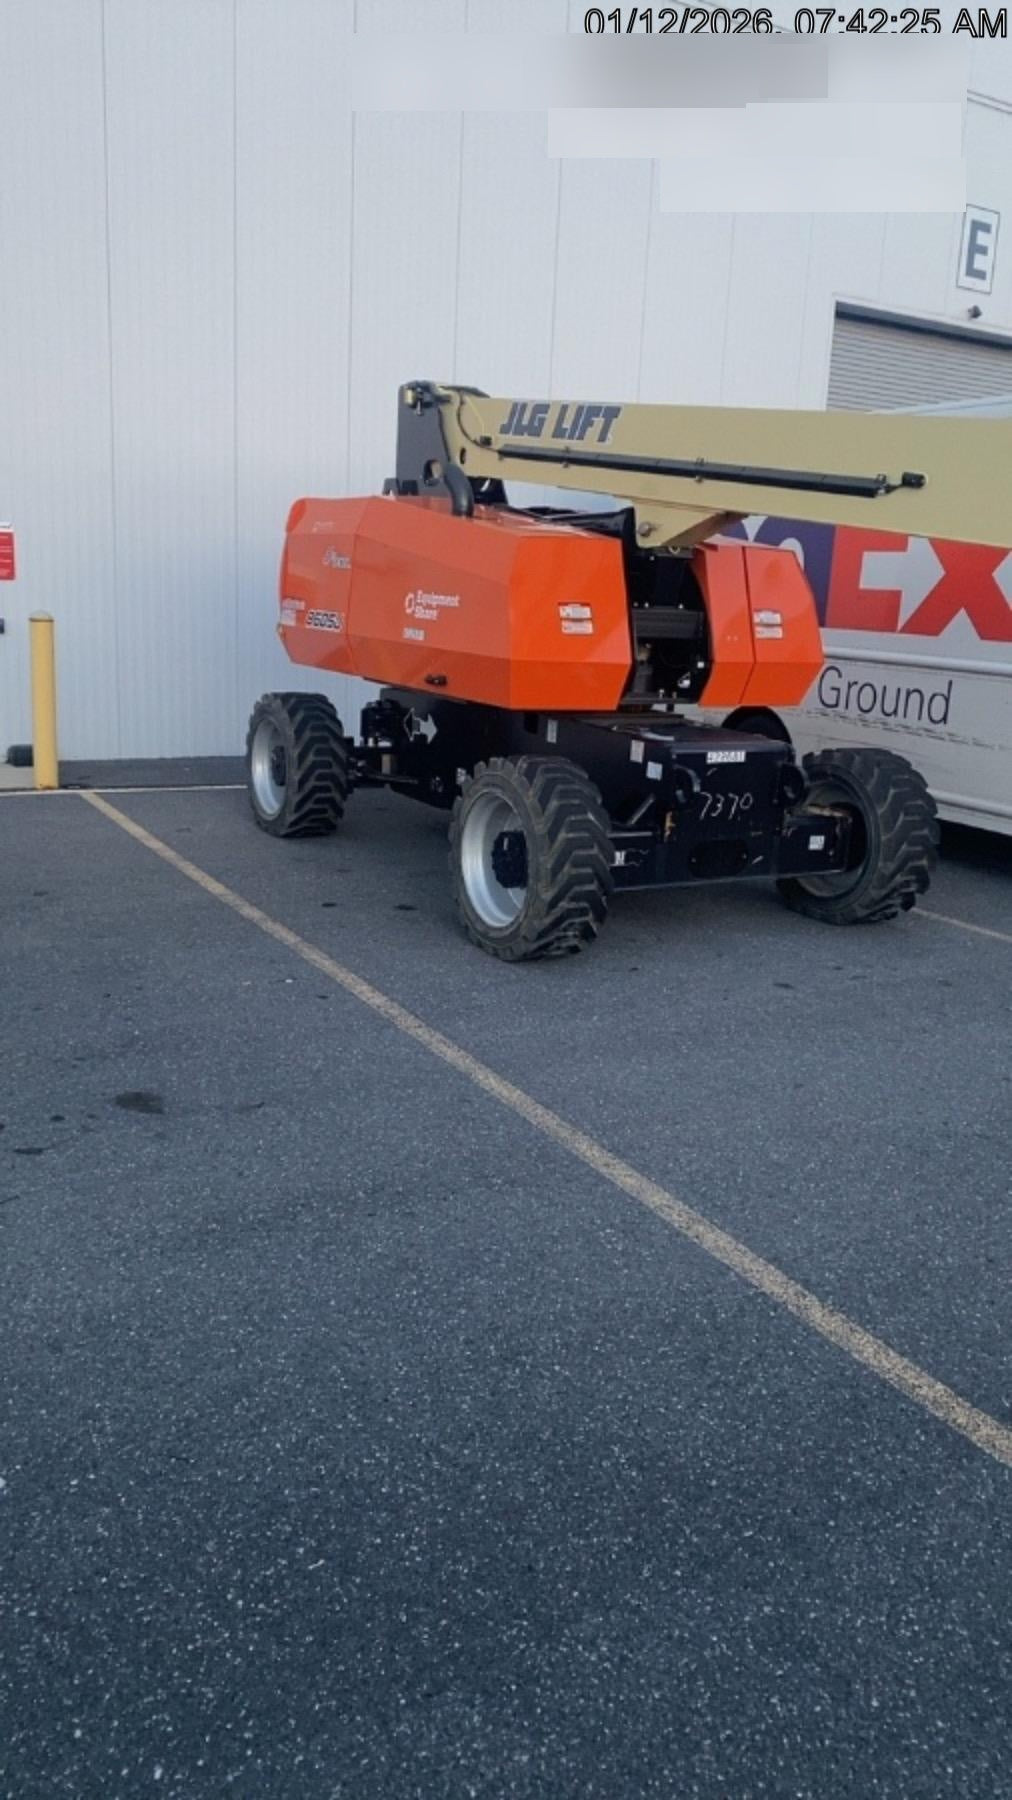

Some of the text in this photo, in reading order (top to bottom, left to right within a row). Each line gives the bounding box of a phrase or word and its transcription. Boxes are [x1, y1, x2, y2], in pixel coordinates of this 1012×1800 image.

[965, 218, 992, 280] E
[500, 402, 621, 443] JLG LIFT
[415, 606, 438, 620] Share
[416, 590, 460, 608] Equipment
[818, 665, 953, 725] Ground
[699, 792, 753, 821] 7370
